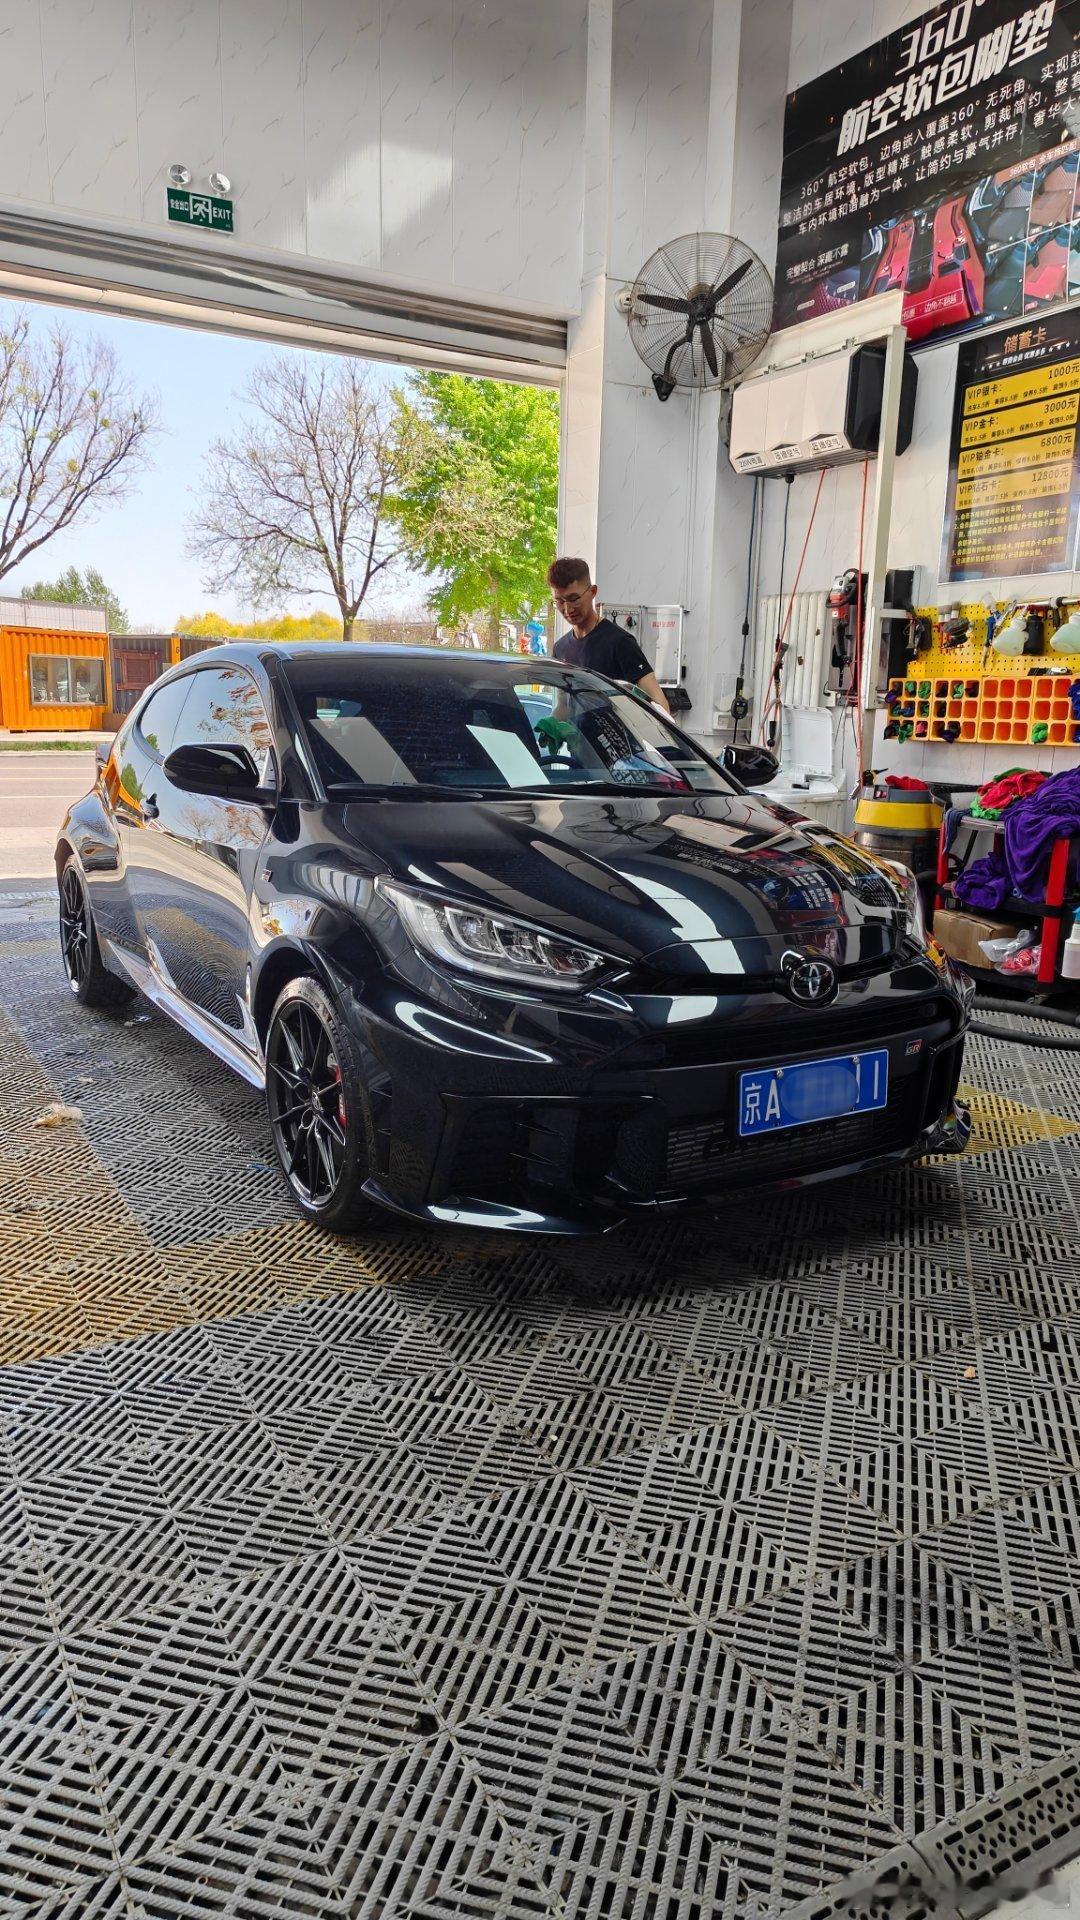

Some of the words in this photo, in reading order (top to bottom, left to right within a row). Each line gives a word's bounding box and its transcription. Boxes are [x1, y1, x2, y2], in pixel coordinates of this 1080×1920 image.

[837, 0, 1056, 156] 航空软包脚垫
[212, 206, 231, 220] EXIT
[1048, 362, 1080, 380] 1000元
[1044, 397, 1076, 414] 3000元
[1040, 432, 1072, 448] 6800元
[905, 1040, 922, 1055] GR
